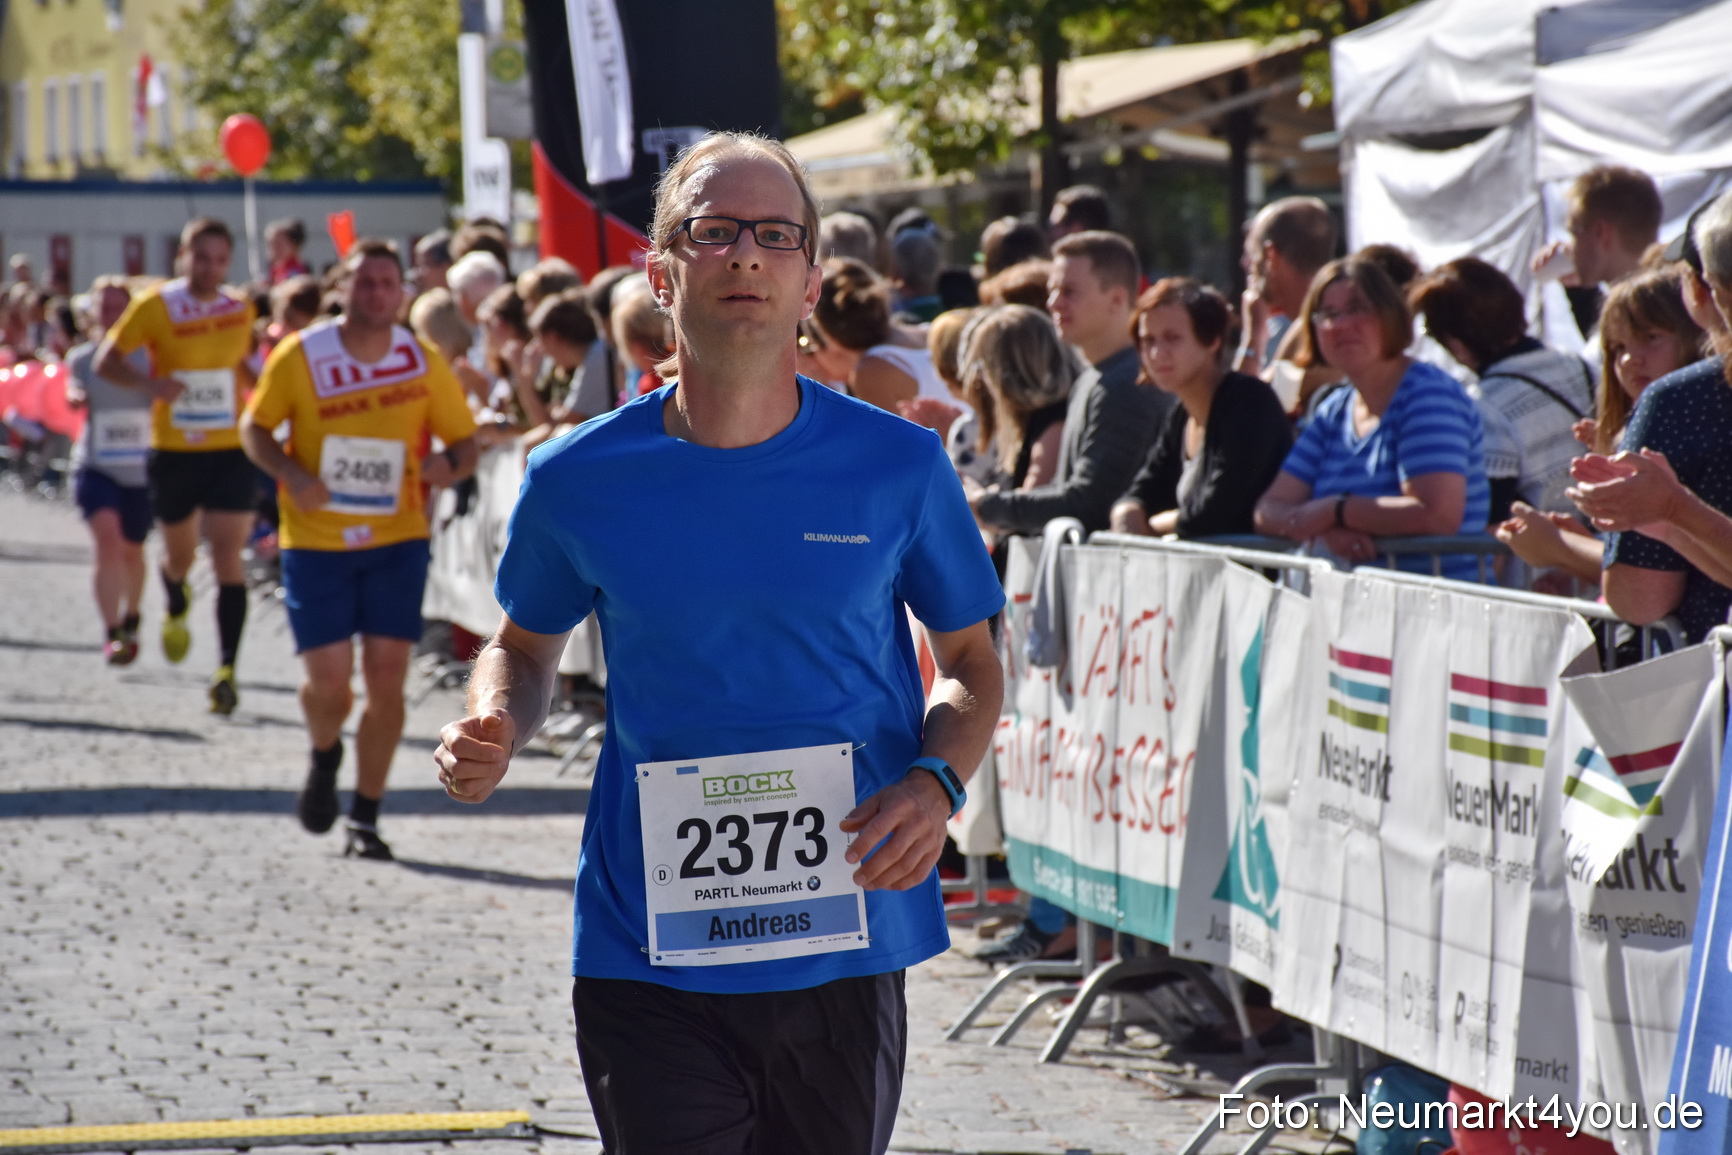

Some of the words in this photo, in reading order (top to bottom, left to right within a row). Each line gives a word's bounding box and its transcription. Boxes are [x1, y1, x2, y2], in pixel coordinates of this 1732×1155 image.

[333, 457, 392, 485] 2408
[804, 532, 870, 544] KILIMANJARO
[702, 769, 796, 798] BOCK
[704, 798, 731, 806] inspired
[767, 792, 797, 801] concepts
[676, 807, 828, 879] 2373
[658, 869, 667, 881] D
[694, 887, 739, 901] PARTL
[742, 881, 803, 897] Neumarkt
[708, 912, 811, 941] Andreas
